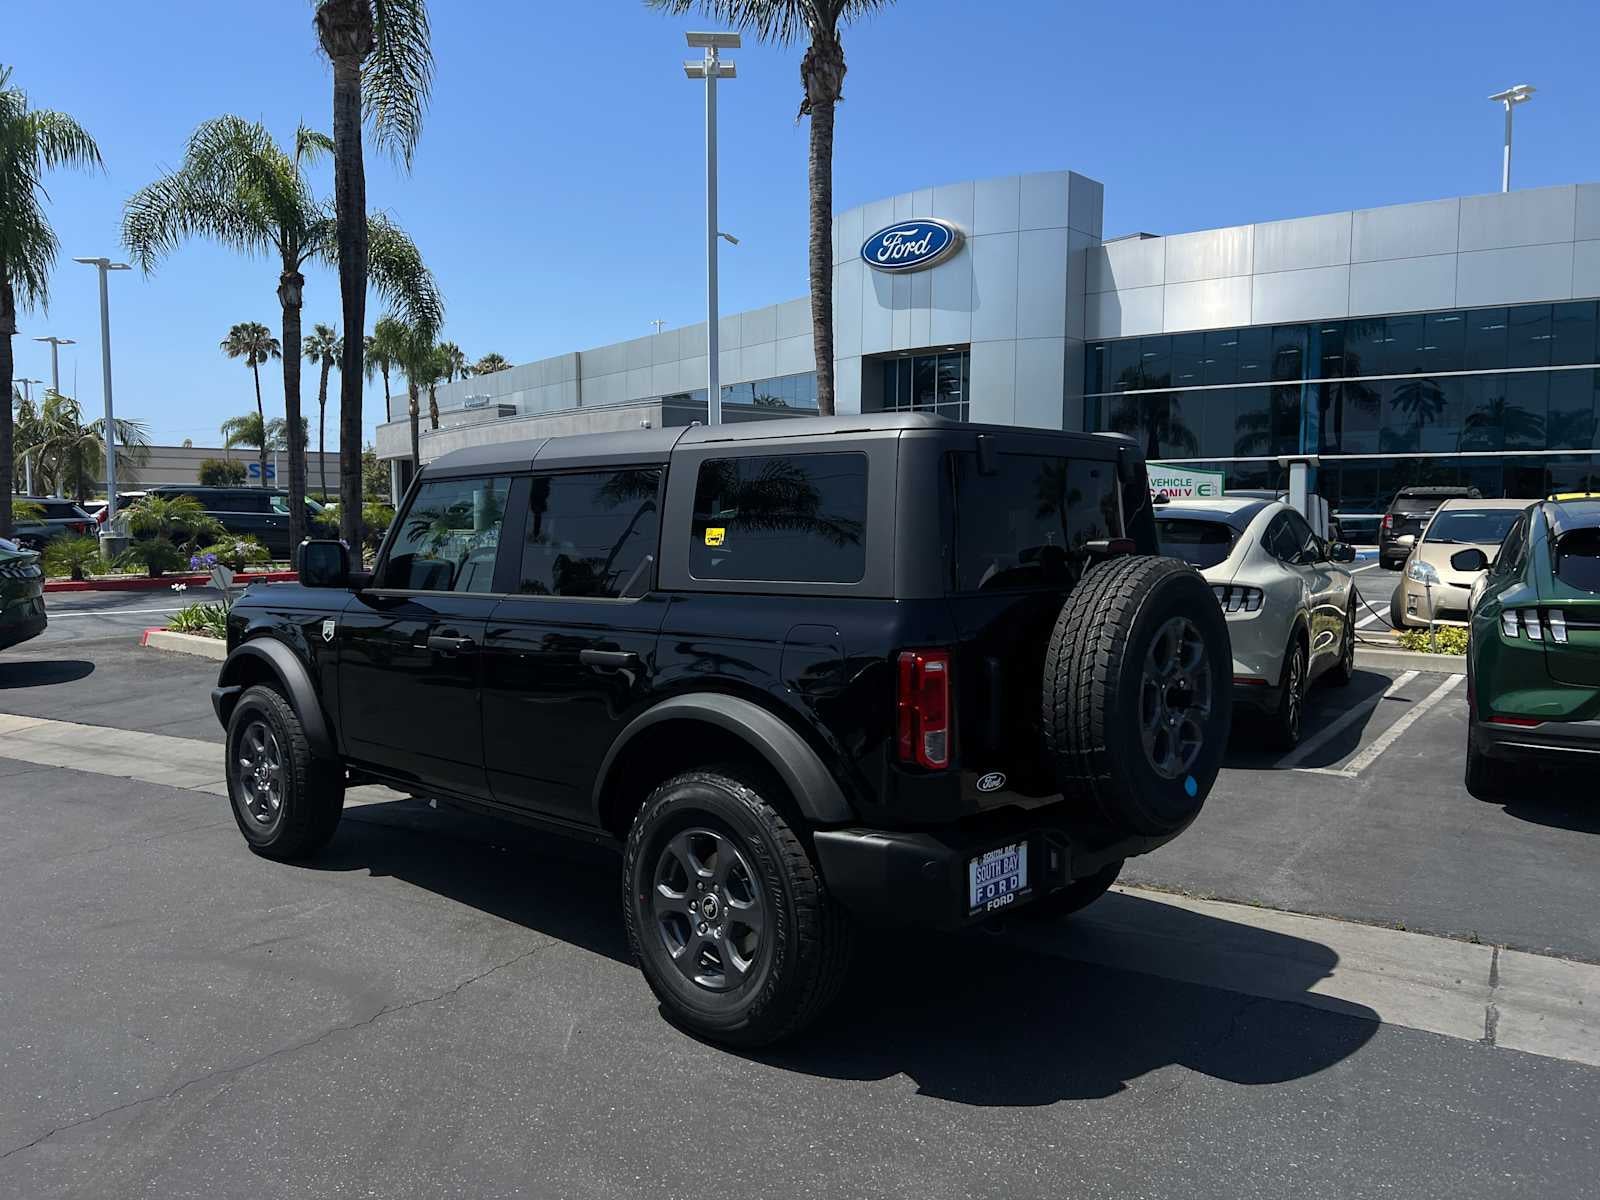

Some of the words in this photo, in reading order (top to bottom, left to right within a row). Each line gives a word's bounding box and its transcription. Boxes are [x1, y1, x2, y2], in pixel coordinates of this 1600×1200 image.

[877, 228, 932, 261] Ford
[1150, 478, 1192, 487] VEHICLE
[982, 775, 1002, 789] Ford
[976, 860, 1001, 883] SOUTH
[1003, 854, 1018, 873] BAY
[976, 876, 1018, 902] FORD
[987, 893, 1014, 911] FORD
